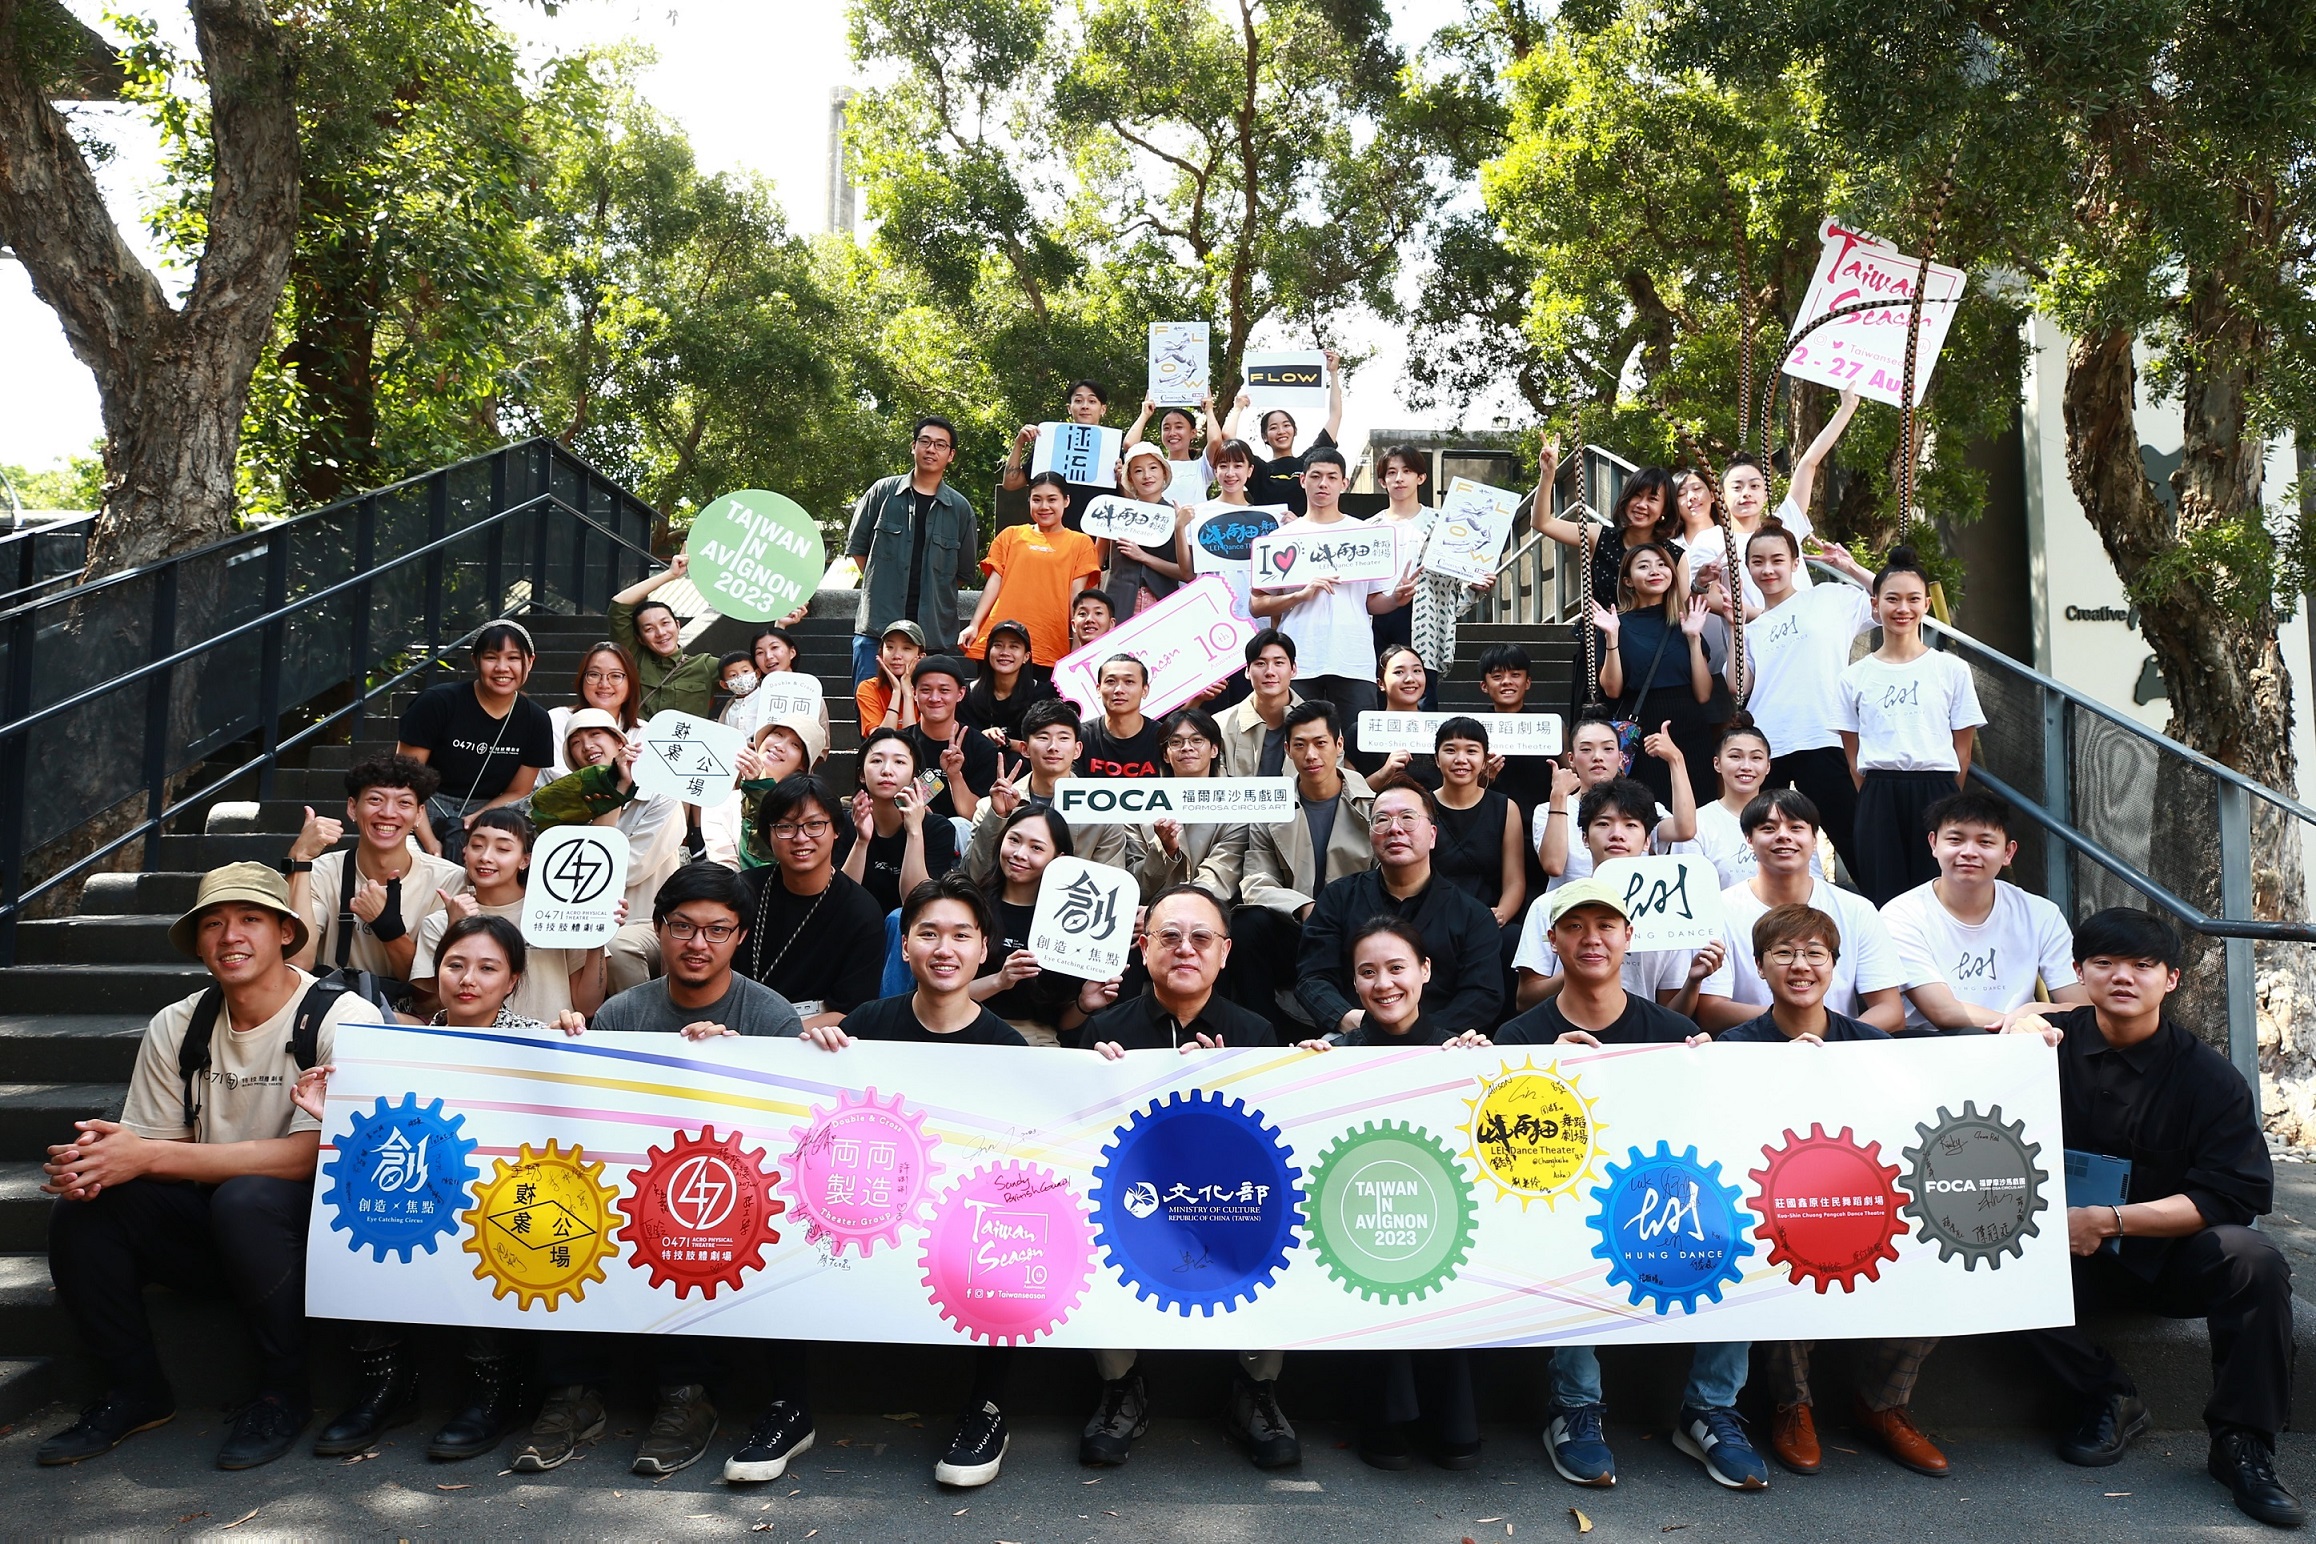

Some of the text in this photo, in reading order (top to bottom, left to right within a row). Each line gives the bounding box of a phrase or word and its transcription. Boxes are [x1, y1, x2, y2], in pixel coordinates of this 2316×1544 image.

[1827, 224, 1917, 298] Taiwa
[1850, 344, 1923, 372] Taiwansean
[1250, 372, 1317, 383] FLOW
[1791, 346, 1808, 365] 2
[1828, 357, 1864, 379] 27
[1868, 369, 1916, 401] Au
[726, 500, 813, 559] TAIWAN
[1259, 545, 1273, 574] I
[699, 540, 802, 603] AVIGNON
[714, 571, 775, 613] 2023
[2066, 605, 2126, 621] Creative
[1368, 718, 1551, 735] 莊國鑫原舞蹈劇場
[453, 739, 475, 751] 0471
[1089, 758, 1157, 777] FOCA
[1062, 789, 1173, 812] FOCA
[1182, 788, 1287, 803] 福爾摩沙馬戲團
[535, 910, 564, 920] 0471
[534, 922, 605, 933] 特技肢體劇場
[1668, 928, 1714, 938] DANCE
[1036, 934, 1067, 955] 創造
[1088, 948, 1120, 967] 焦點
[1044, 954, 1107, 974] Eye Catching Circus
[832, 1115, 865, 1128] Double
[879, 1117, 903, 1133] Cross
[1510, 1146, 1538, 1154] Dance
[1540, 1146, 1575, 1154] Theater
[824, 1173, 892, 1208] 製造
[994, 1173, 1031, 1192] Sandy
[1355, 1181, 1418, 1196] TAIWAN
[1925, 1180, 1977, 1193] FOCA
[1162, 1181, 1270, 1205] 文化部
[359, 1198, 435, 1214] 創造 焦點
[1774, 1195, 1884, 1209] 莊國鑫原住民舞蹈劇場
[378, 1216, 404, 1224] Catching
[820, 1208, 892, 1226] Theater Group
[963, 1197, 1037, 1244] Taiwan
[1168, 1214, 1199, 1222] REPUBLIC
[1209, 1214, 1230, 1222] CHINA
[1232, 1214, 1261, 1222] (TAIWAN)
[1355, 1213, 1428, 1229] AVIGNON
[662, 1236, 690, 1247] 0471
[1374, 1230, 1416, 1246] 2023
[661, 1249, 732, 1261] 特技肢體劇場
[976, 1239, 1044, 1276] Season
[1680, 1250, 1722, 1259] DANCE
[1024, 1265, 1048, 1285] 10
[998, 1290, 1046, 1299] Taiwanseason
